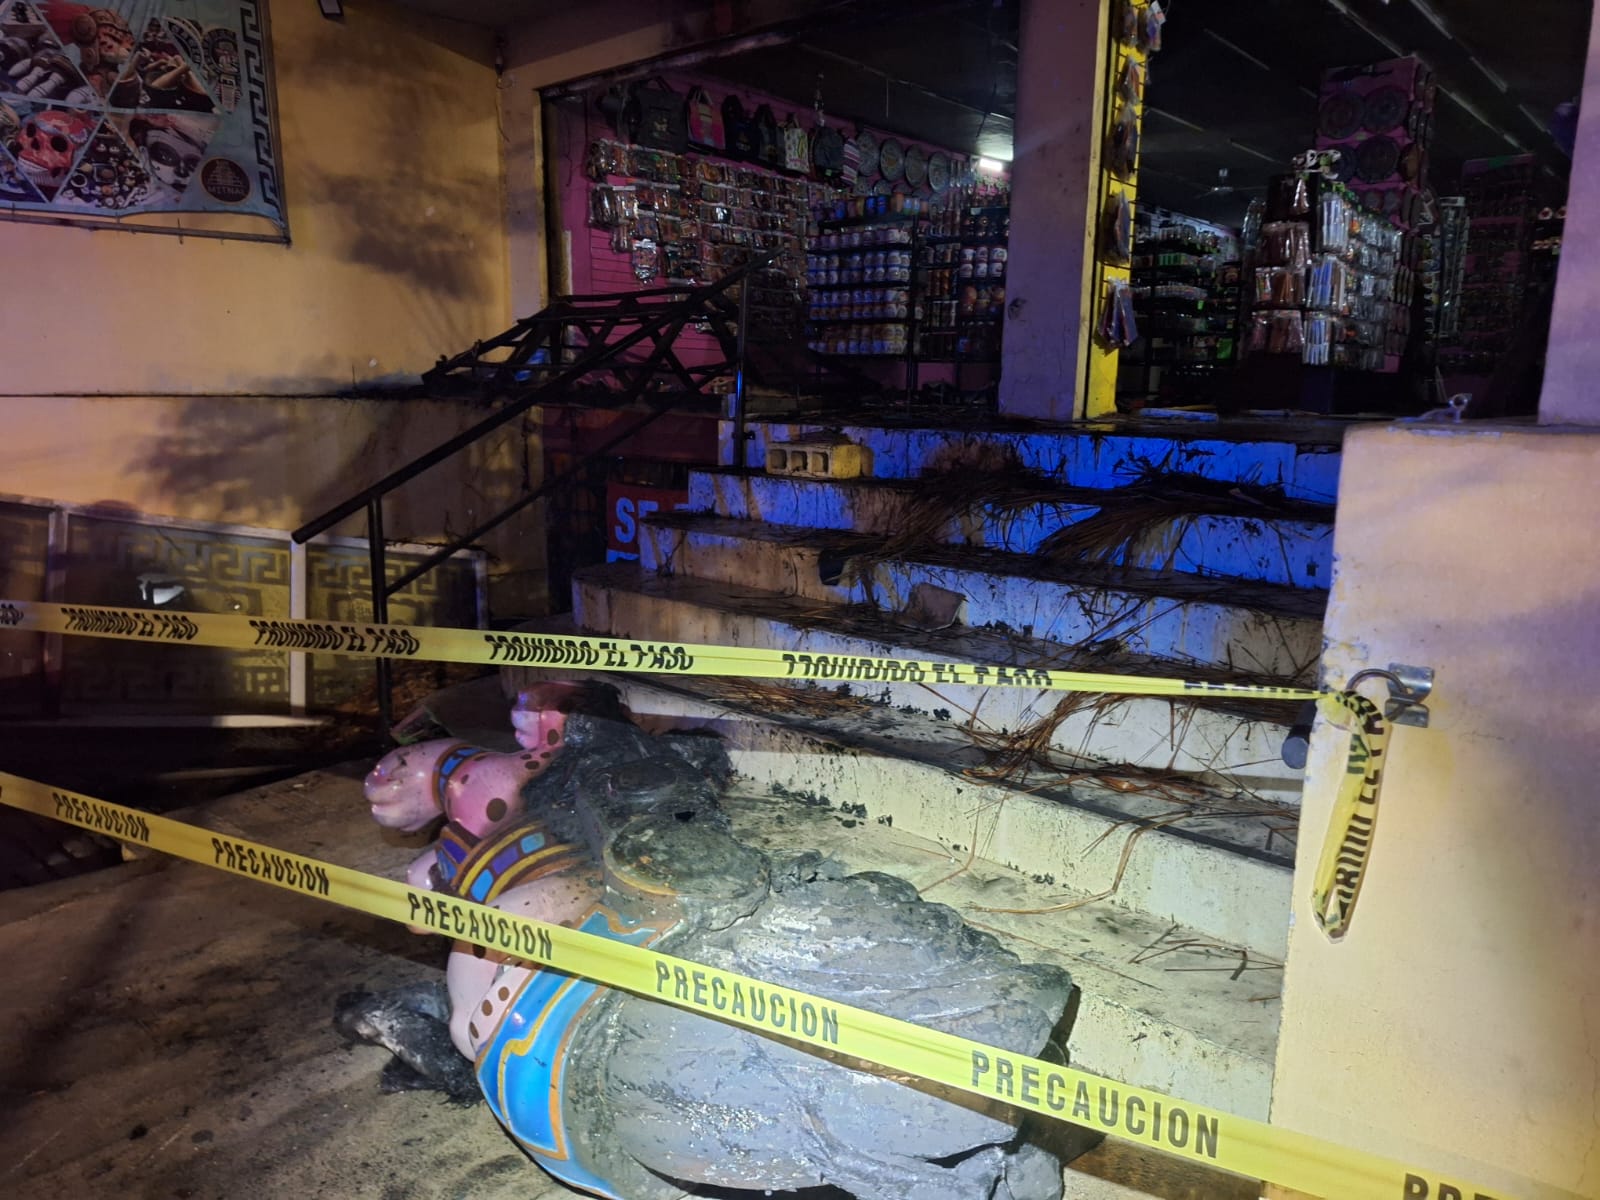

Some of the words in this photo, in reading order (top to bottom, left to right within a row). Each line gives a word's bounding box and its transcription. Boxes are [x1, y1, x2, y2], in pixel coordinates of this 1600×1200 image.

[61, 607, 138, 636] PROHIBIDO
[134, 612, 155, 636] EL
[154, 614, 199, 640] PASO
[249, 620, 345, 650] PROHIBIDO
[340, 626, 367, 652] EL
[366, 627, 420, 656] PASO
[484, 634, 600, 666] PROHIBIDO
[599, 642, 628, 667] EL
[630, 644, 694, 671] PASO
[52, 792, 150, 842] PRECAUCION
[211, 837, 330, 896] PRECAUCION
[407, 892, 552, 961] PRECAUCION
[655, 960, 840, 1045] PRECAUCION
[971, 1049, 1219, 1159] PRECAUCION
